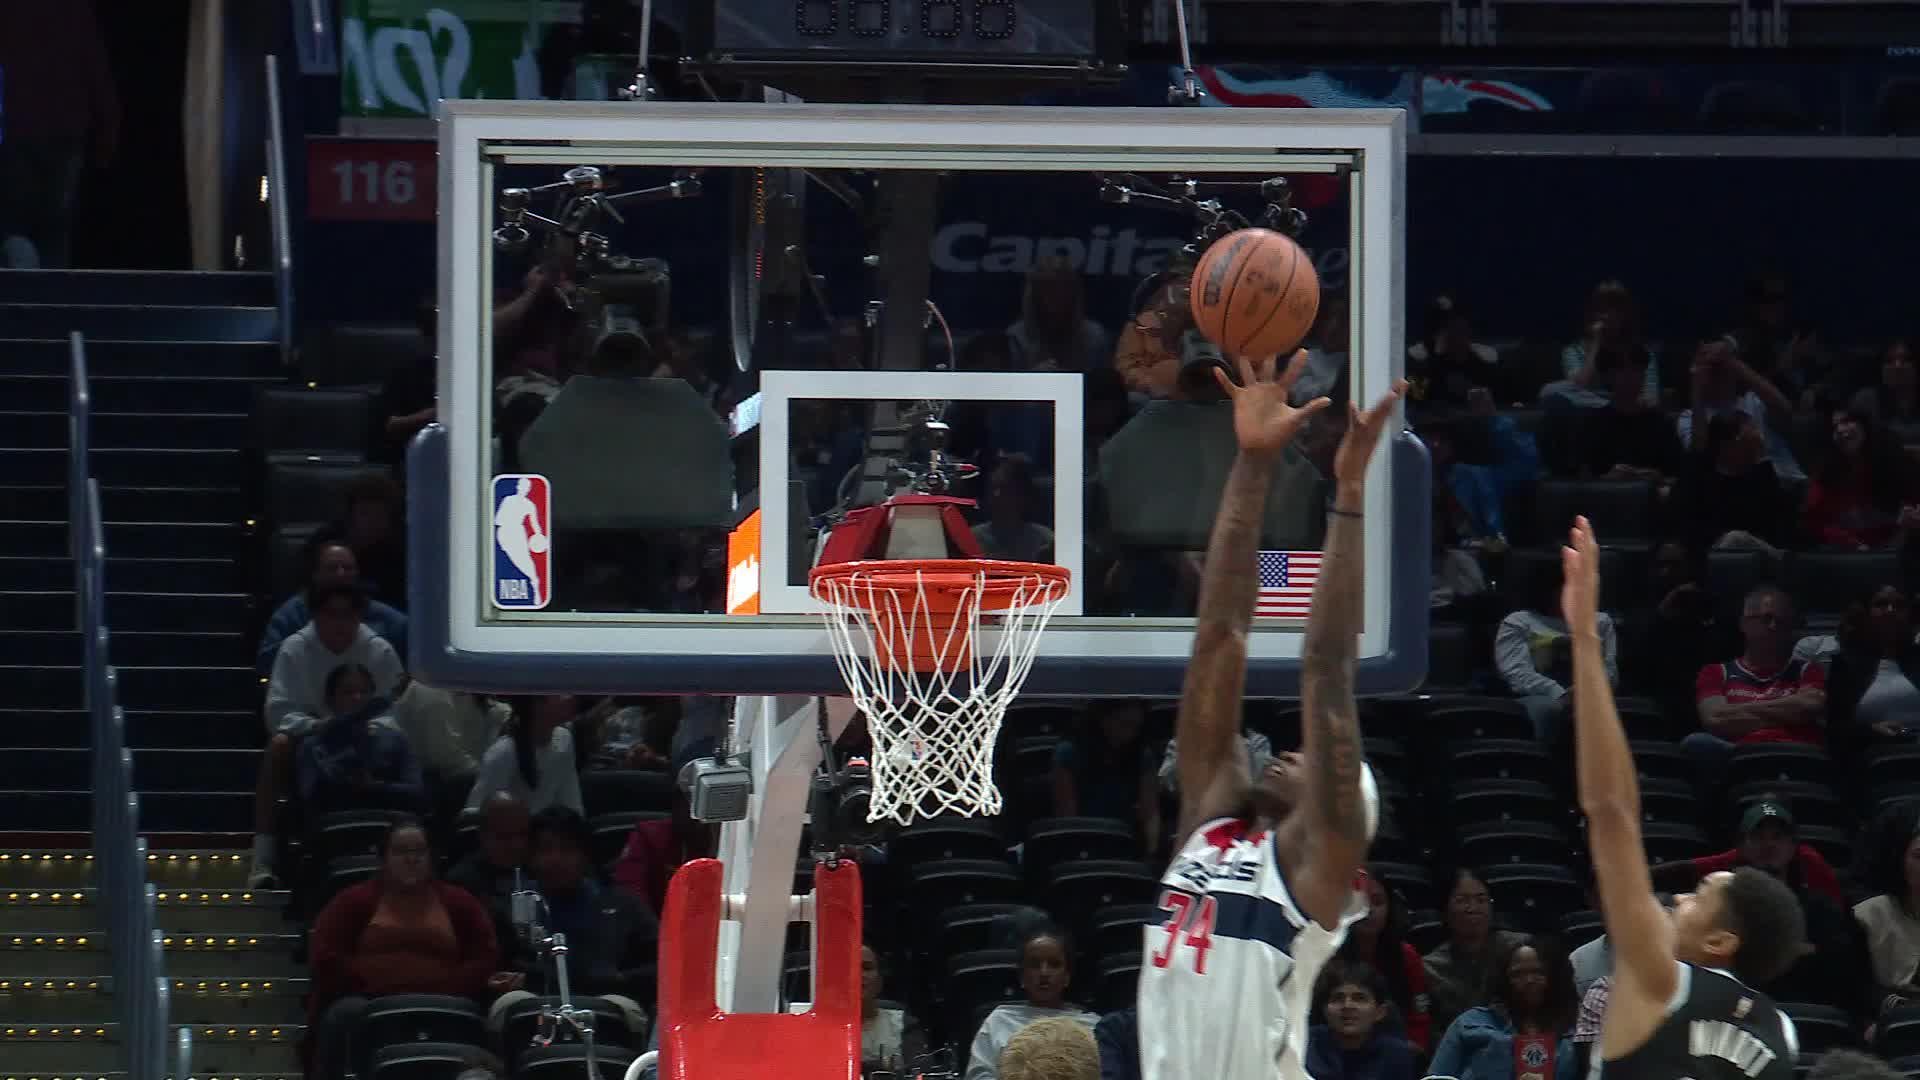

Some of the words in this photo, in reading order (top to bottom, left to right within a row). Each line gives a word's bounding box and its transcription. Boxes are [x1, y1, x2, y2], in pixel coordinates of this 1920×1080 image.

[332, 160, 416, 204] 116
[930, 221, 1184, 275] Capita
[499, 578, 529, 600] NBA
[1152, 890, 1218, 976] 34
